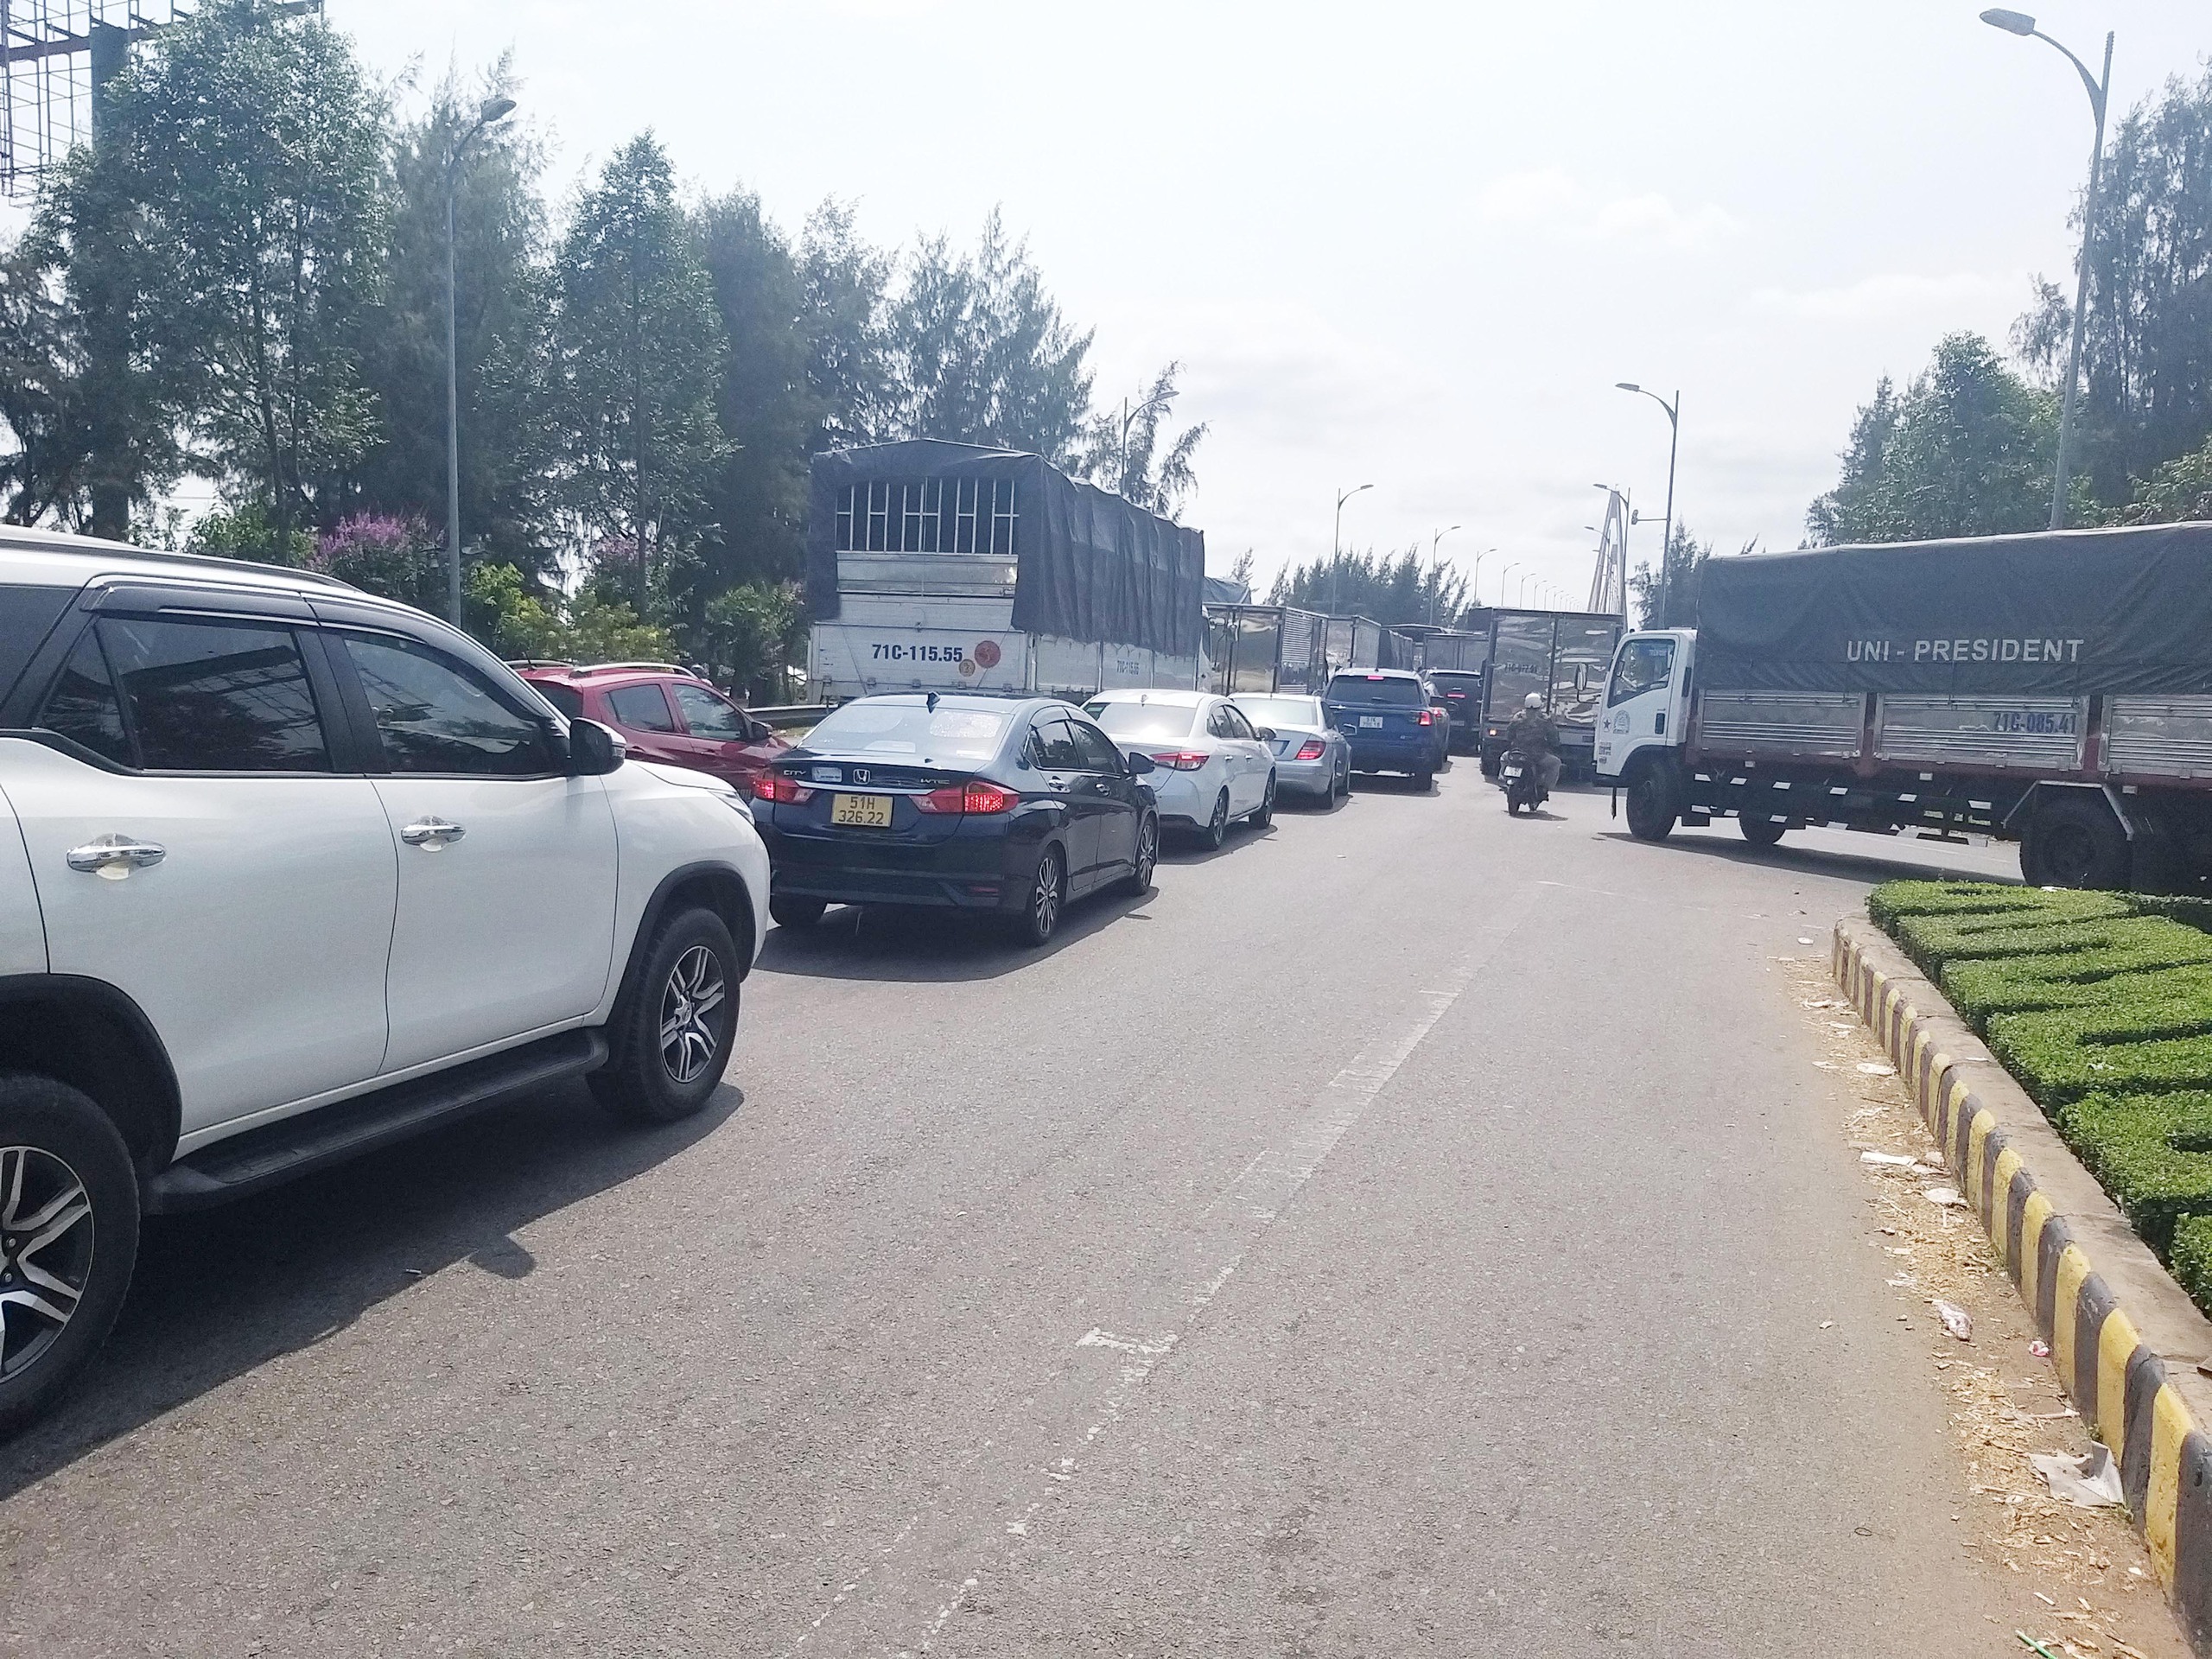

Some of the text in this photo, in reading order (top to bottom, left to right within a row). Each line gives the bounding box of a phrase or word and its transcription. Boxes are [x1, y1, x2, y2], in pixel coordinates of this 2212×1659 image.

[872, 643, 963, 663] 71C-115.55
[1846, 639, 1890, 662] UNI
[1914, 639, 2084, 662] PRESIDENT
[1993, 711, 2076, 734] 71C-085.41
[849, 796, 875, 810] 51H
[838, 810, 885, 825] 326.22
